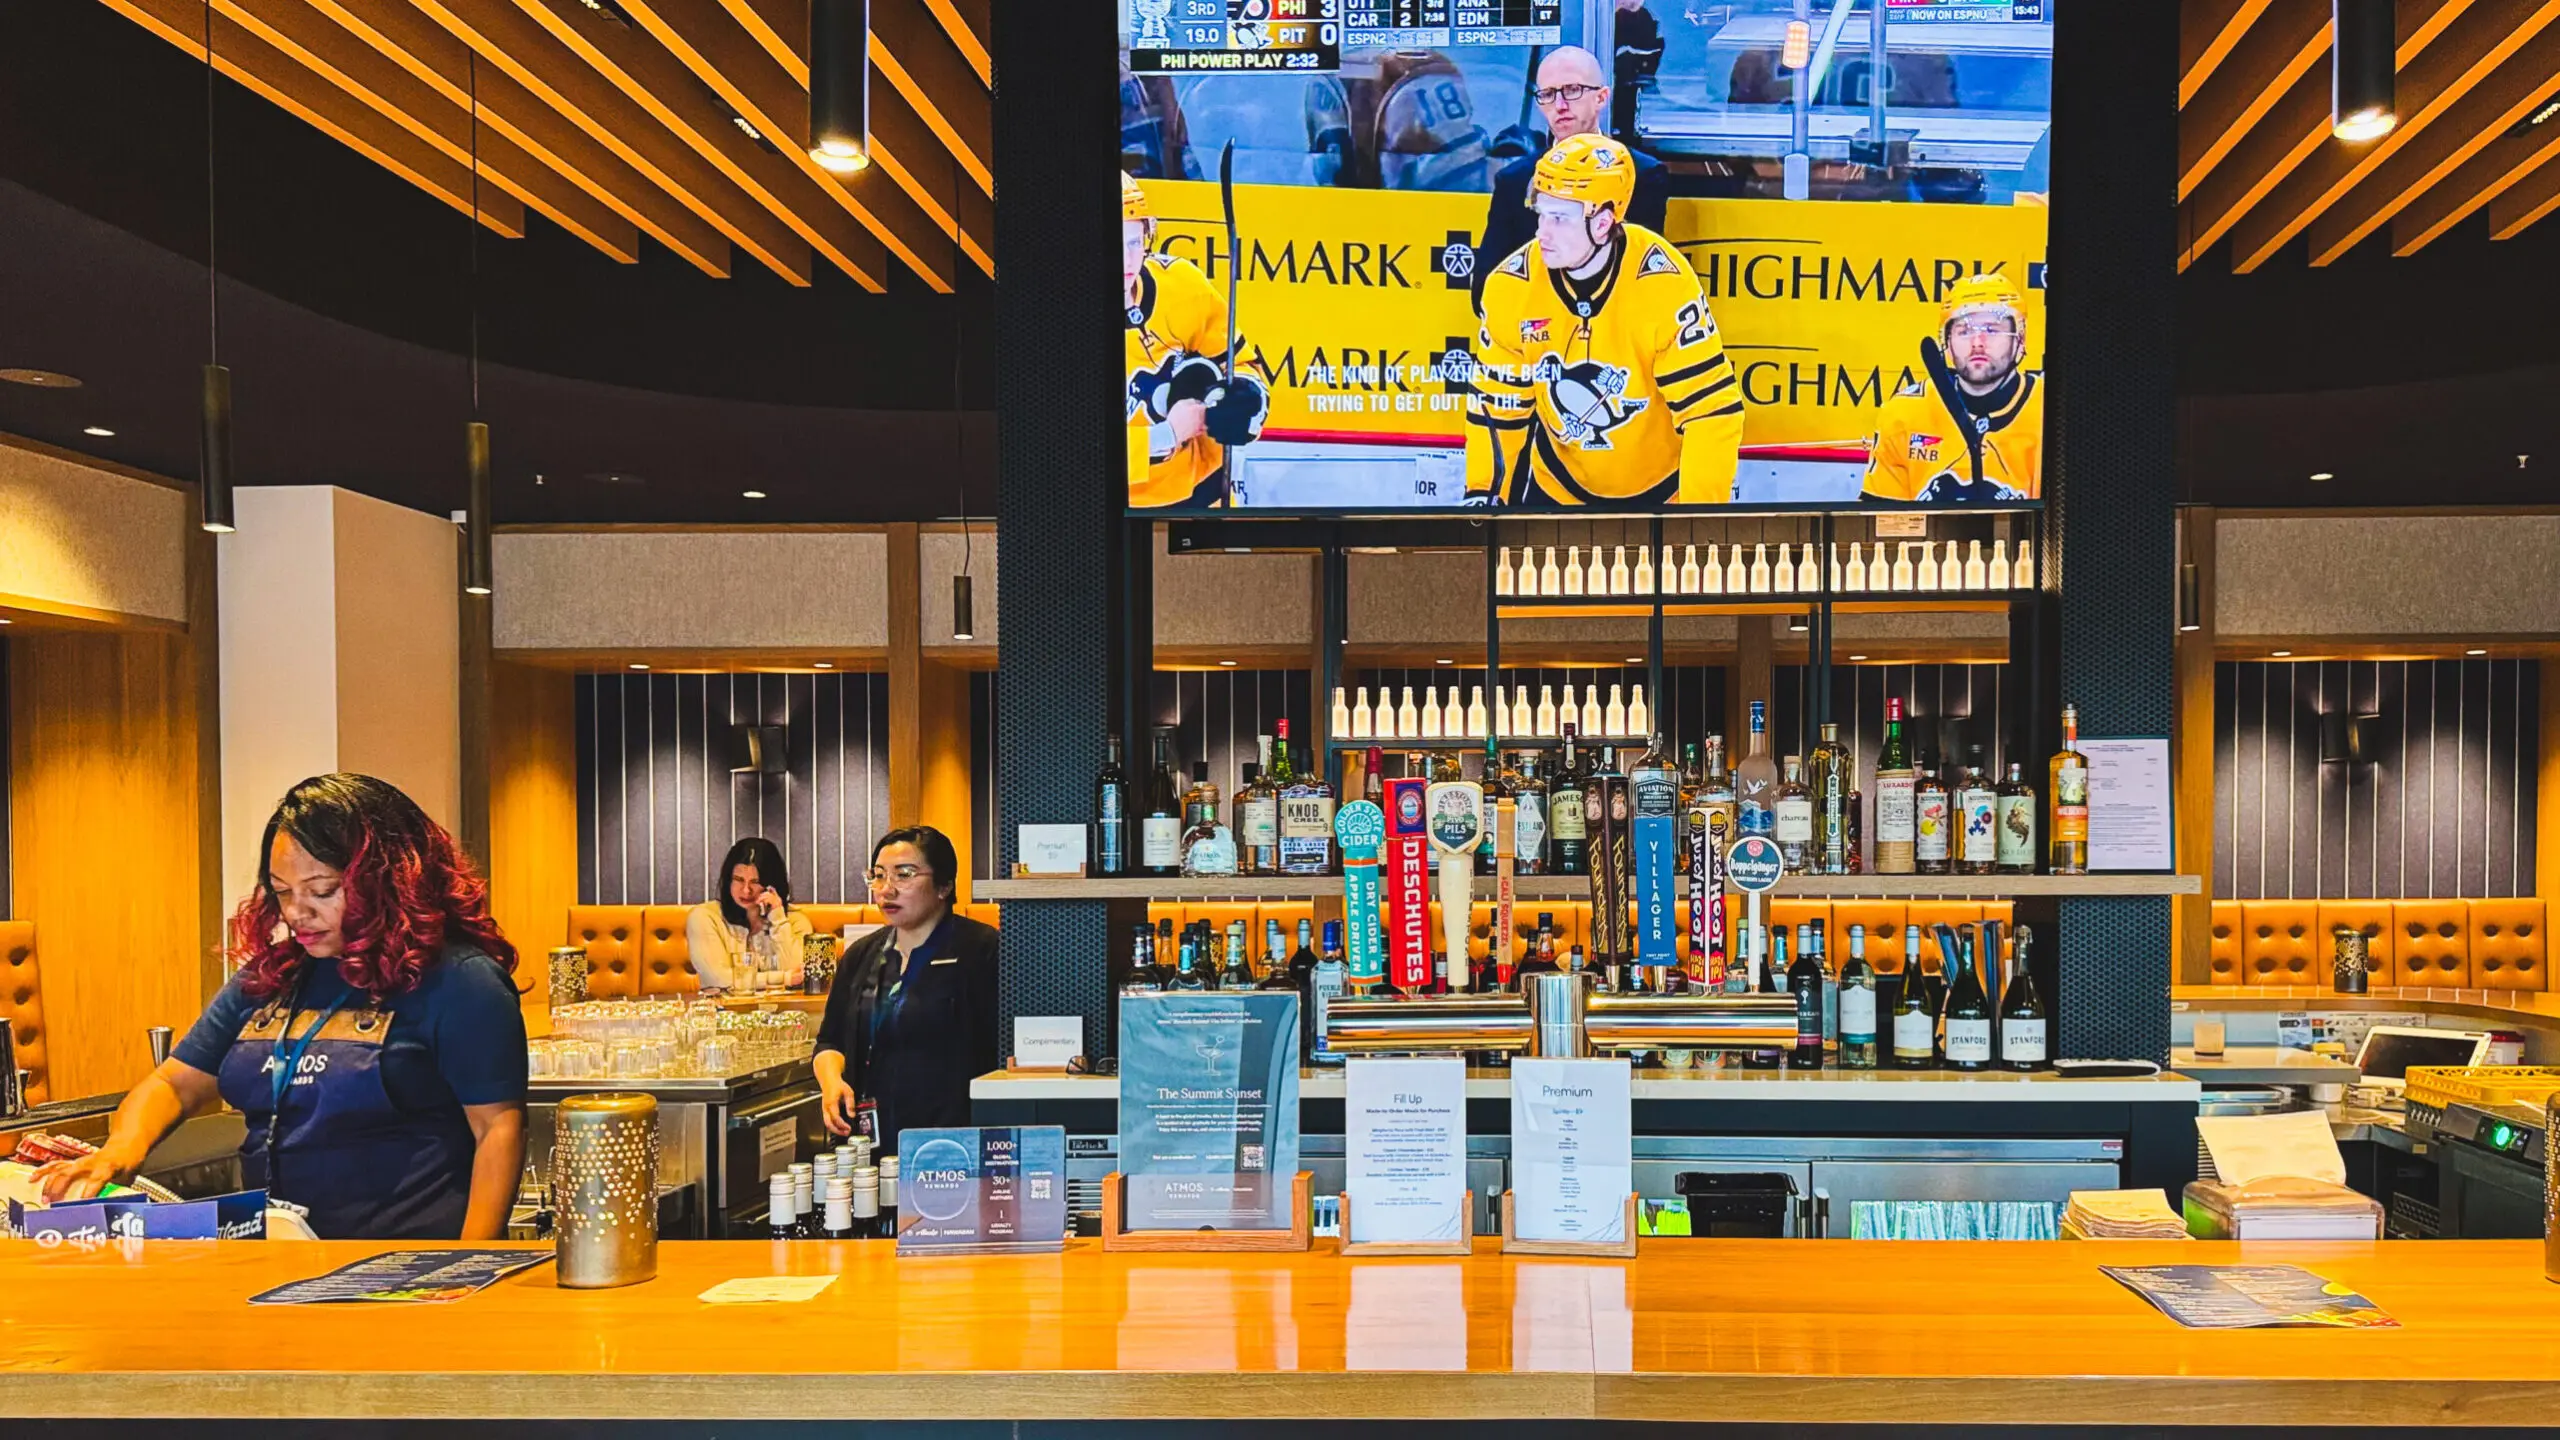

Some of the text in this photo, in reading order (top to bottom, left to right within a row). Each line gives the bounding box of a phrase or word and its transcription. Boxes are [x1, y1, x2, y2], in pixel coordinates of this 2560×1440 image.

[1186, 2, 1216, 16] 3RD
[1278, 0, 1338, 18] PHI 3
[1911, 10, 1935, 21] NOW
[1937, 10, 1951, 21] ON
[1347, 13, 1379, 27] CAR
[1399, 12, 1412, 27] 2
[1457, 12, 1489, 26] EDM
[1185, 28, 1219, 44] 19.0
[1279, 23, 1338, 46] PIT 0
[1347, 32, 1387, 45] ESPN2
[1457, 31, 1497, 44] ESPN2
[1160, 52, 1320, 69] PHI POWER PLAY 2:32
[1307, 363, 1563, 384] THE KIND OF PLAY THEY'VE BEEN
[1307, 392, 1522, 413] TRYING TO GET OUT OF THE
[1638, 784, 1674, 793] AVIATION
[1552, 794, 1584, 805] JAMES
[1288, 803, 1320, 818] KNOB
[1338, 803, 1361, 834] GOLDEN
[1363, 803, 1382, 832] STATE
[1444, 824, 1467, 834] PILS
[1341, 834, 1379, 847] CIDER
[1690, 832, 1705, 883] JUICY
[1711, 833, 1724, 882] JUICY
[1649, 840, 1662, 941] VILLAGER
[1365, 881, 1377, 955] DRY CIDER
[1402, 840, 1424, 982] DESCHUTES
[1690, 883, 1704, 949] HOOT
[1710, 881, 1723, 949] HOOT
[1348, 873, 1361, 972] APPLE DRIVEN
[1690, 963, 1704, 980] IPA
[1710, 964, 1723, 981] IPA
[1022, 1036, 1076, 1047] Complimentary
[1951, 1037, 1987, 1046] STANFORD
[1157, 1087, 1262, 1100] The Summit Sunset
[1542, 1084, 1593, 1098] Premium
[1393, 1093, 1422, 1105] Fill Up
[986, 1141, 1018, 1151] 1,000+
[916, 1170, 966, 1182] ATMOS
[992, 1175, 1011, 1186] 30+
[1164, 1182, 1205, 1193] ATMOS
